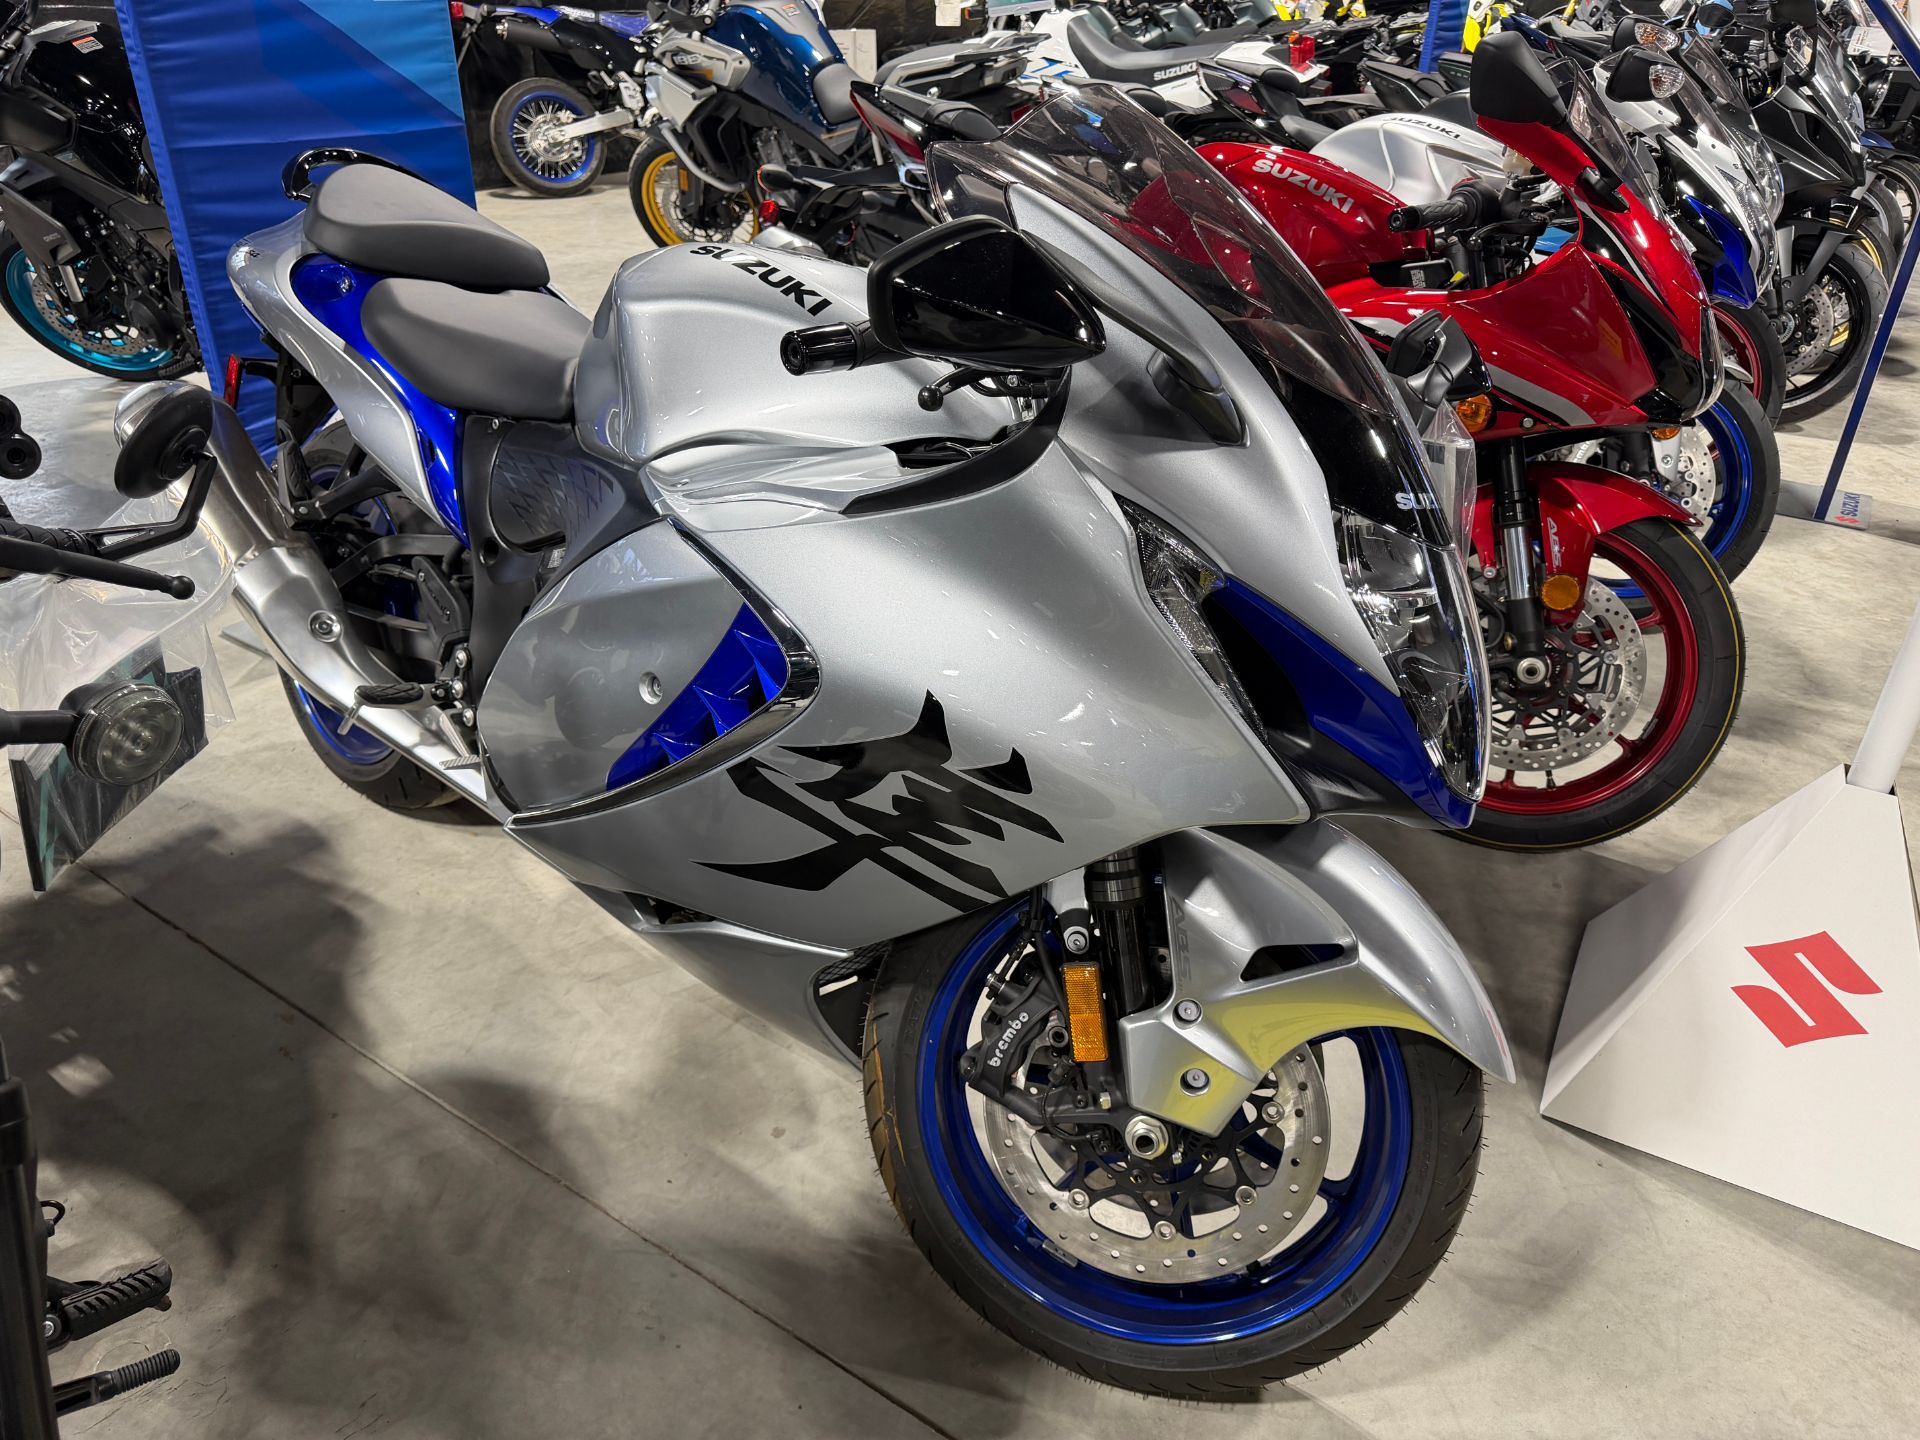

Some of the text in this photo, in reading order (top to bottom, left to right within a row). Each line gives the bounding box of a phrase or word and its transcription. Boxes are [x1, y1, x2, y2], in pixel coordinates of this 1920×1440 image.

[1153, 61, 1197, 81] SUZUKI
[1251, 158, 1355, 214] SUZUKI
[689, 245, 833, 317] SUZUKI
[1168, 895, 1192, 982] ABS
[987, 1011, 1029, 1067] brembo
